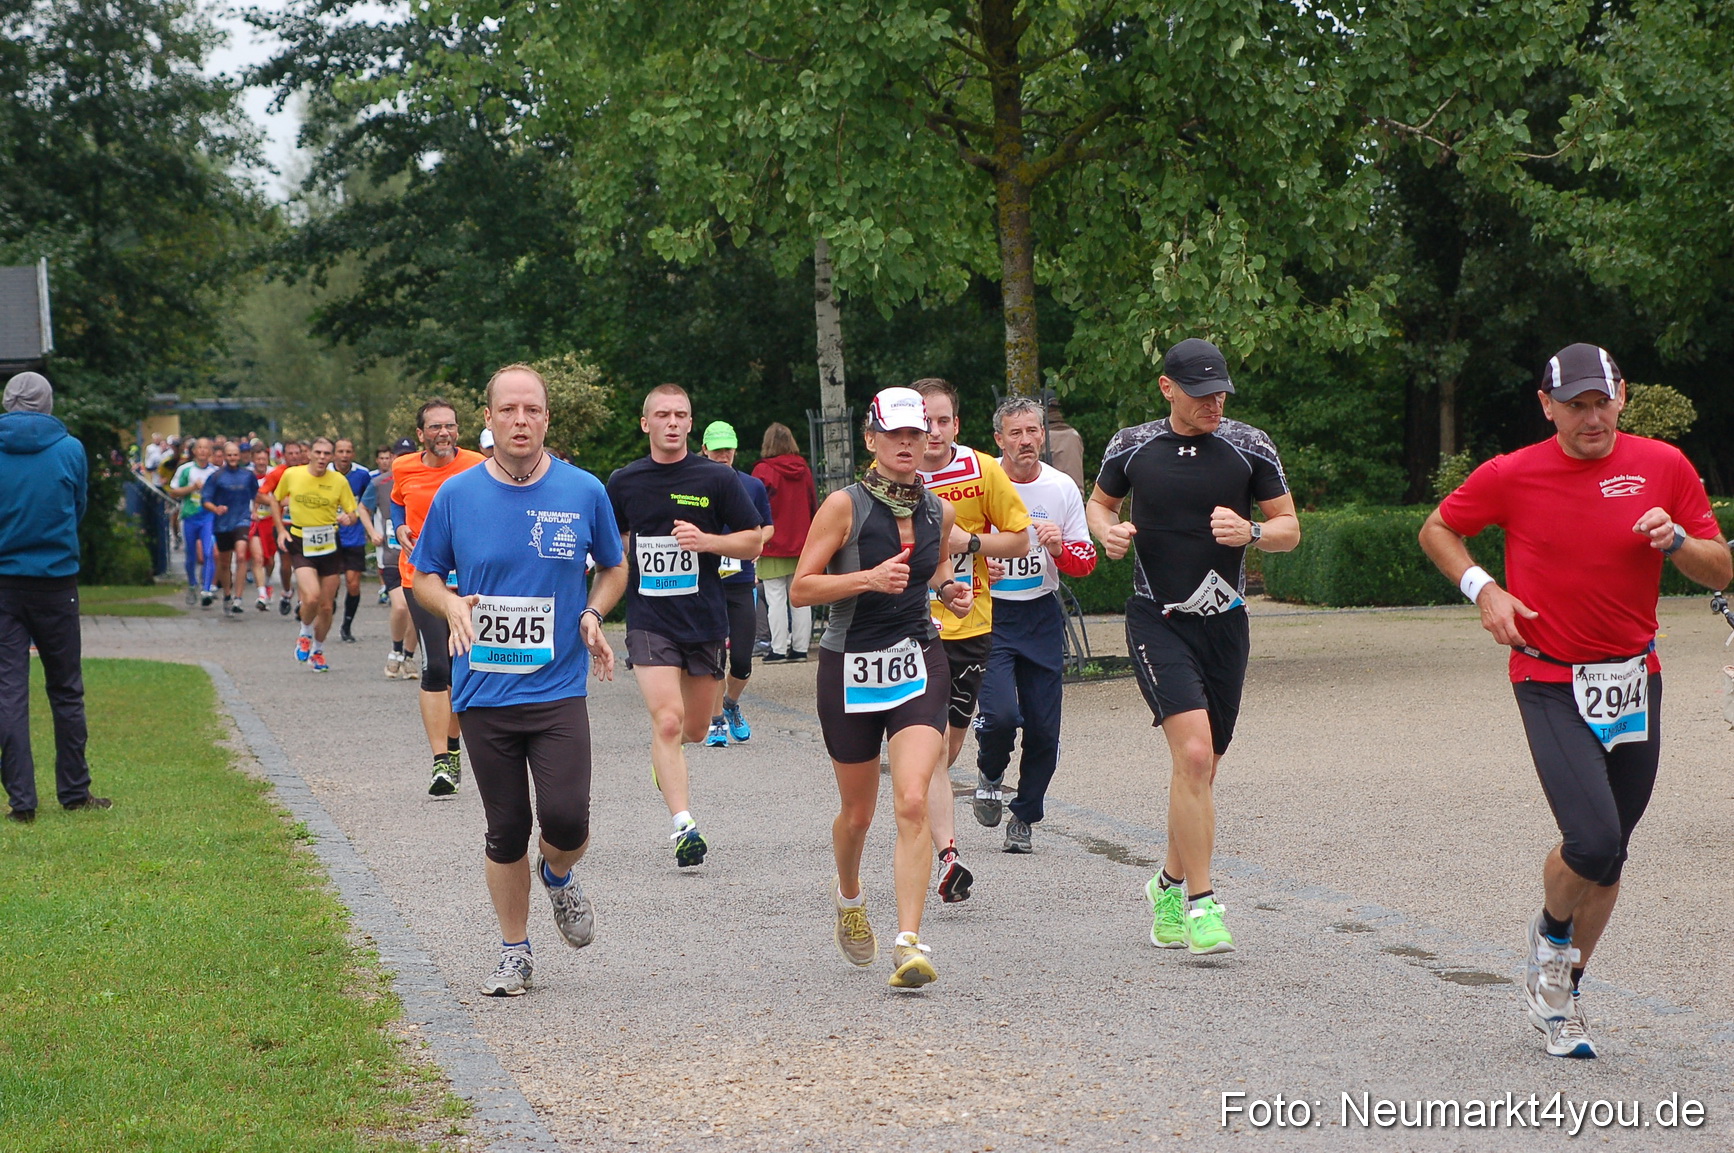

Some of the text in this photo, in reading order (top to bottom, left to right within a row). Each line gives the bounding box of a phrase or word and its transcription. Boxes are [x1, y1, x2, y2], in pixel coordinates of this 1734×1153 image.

[536, 516, 573, 524] STADTLAUF
[538, 510, 580, 520] NEUMARKTER
[310, 533, 329, 544] 451
[642, 550, 693, 573] 2678
[655, 578, 678, 589] Björn
[499, 604, 539, 613] Neumarkt
[478, 614, 545, 644] 2545
[487, 650, 533, 662] Joachim
[853, 653, 918, 684] 3168
[1575, 673, 1608, 681] PARTL
